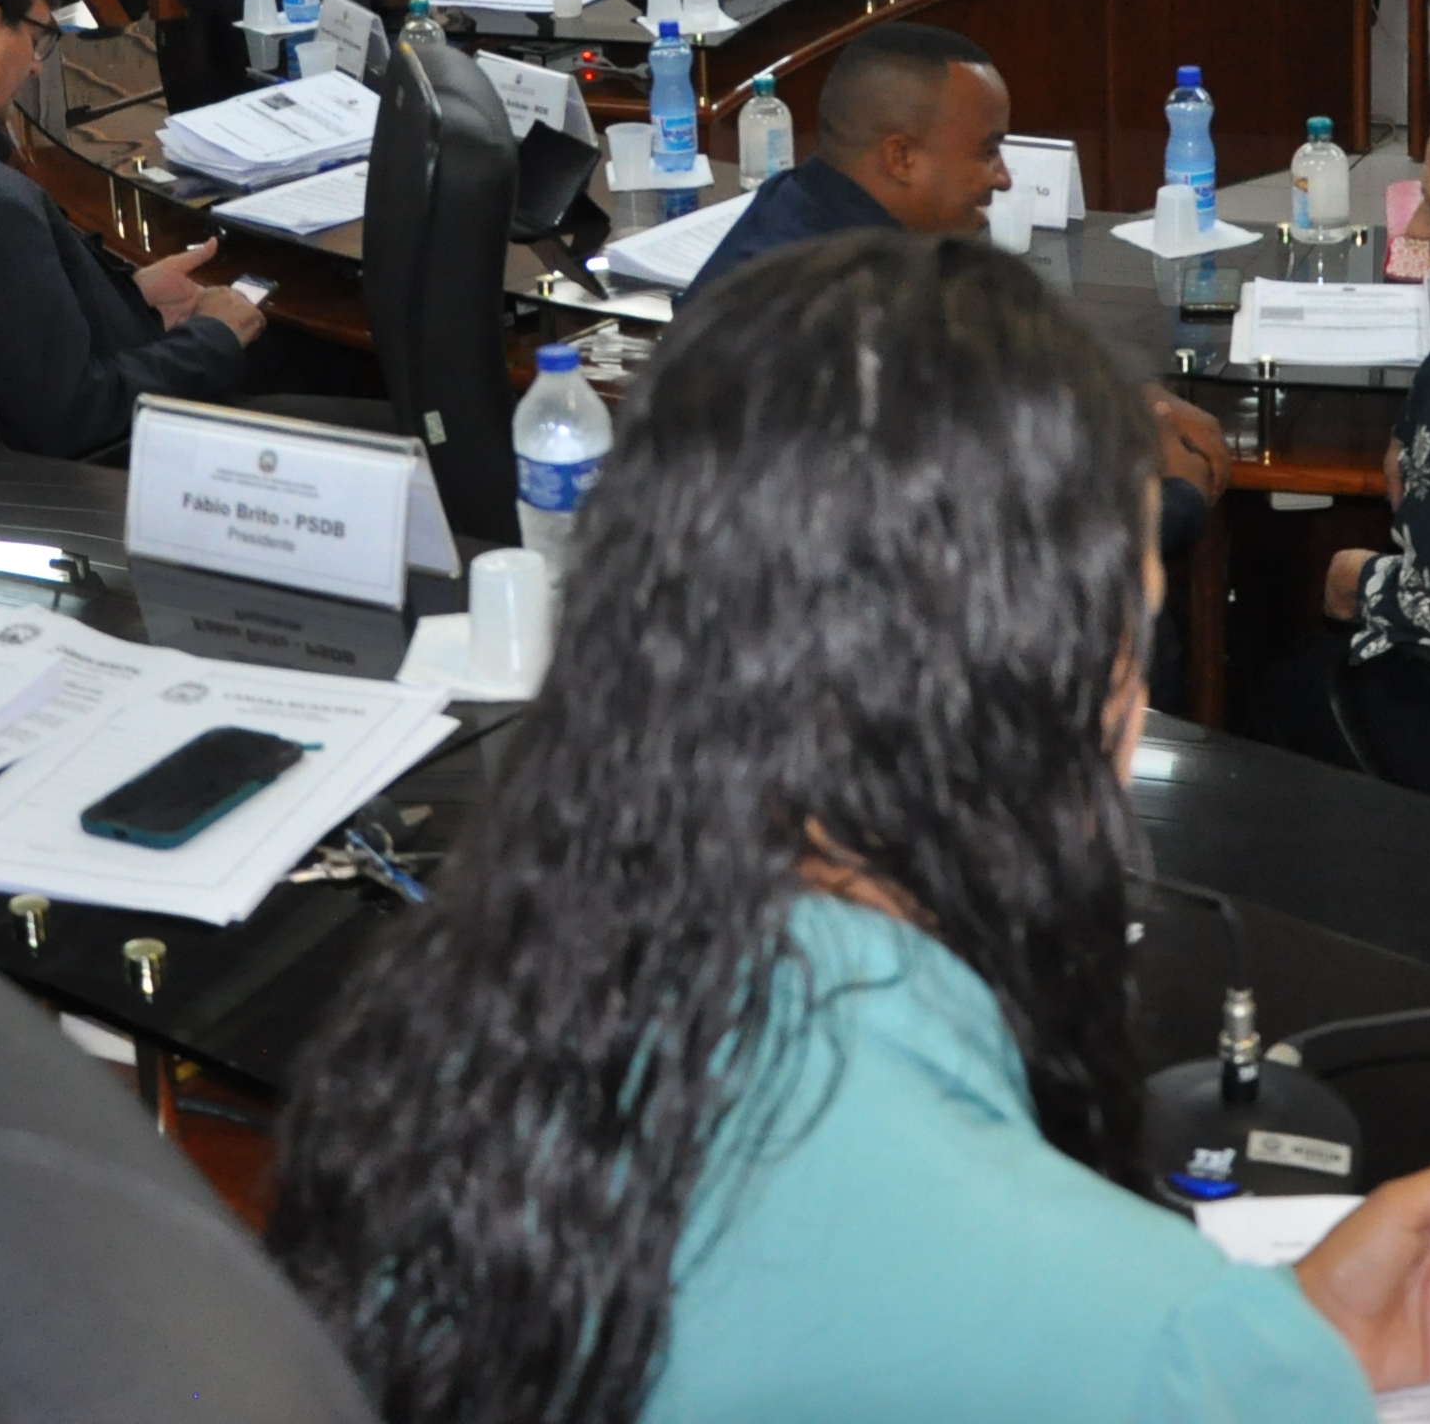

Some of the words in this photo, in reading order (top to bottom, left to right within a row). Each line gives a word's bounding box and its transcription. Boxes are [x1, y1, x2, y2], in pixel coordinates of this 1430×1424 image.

[181, 491, 230, 516] Fábio
[236, 502, 279, 526] Brito
[295, 513, 346, 538] PSDB
